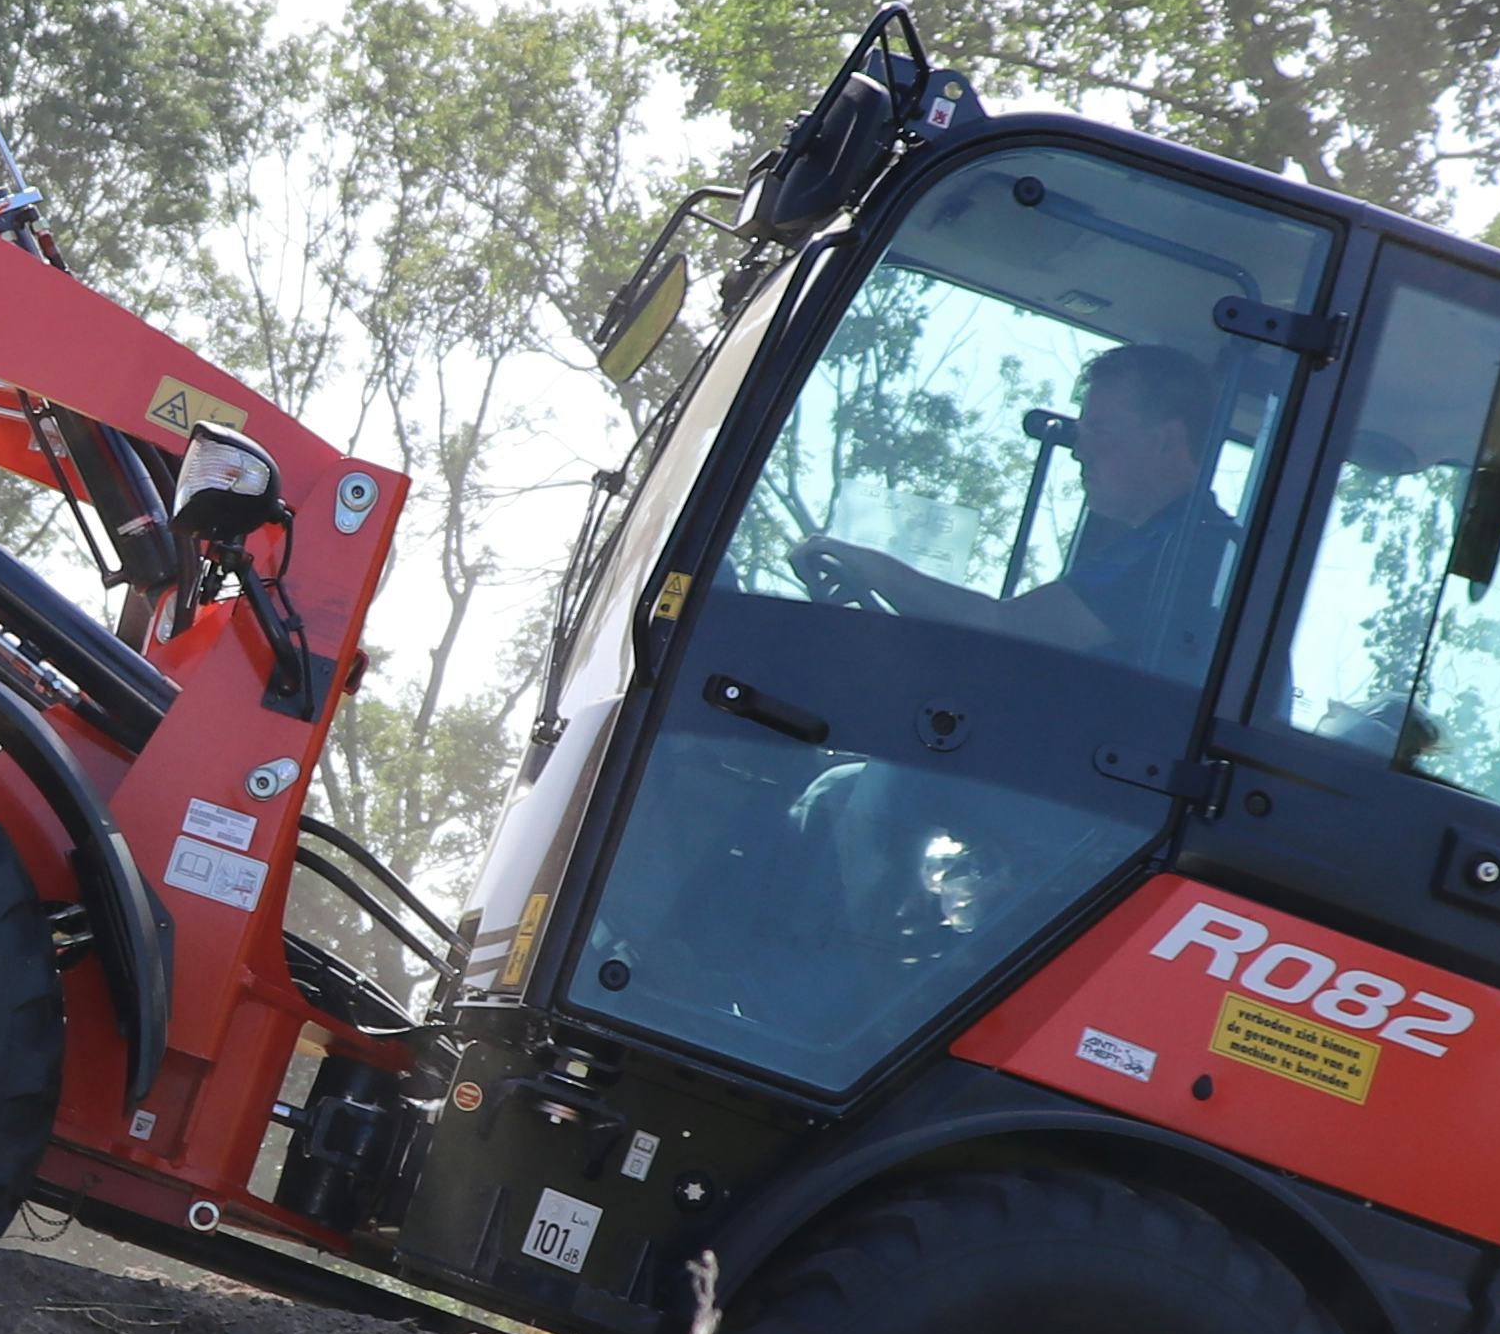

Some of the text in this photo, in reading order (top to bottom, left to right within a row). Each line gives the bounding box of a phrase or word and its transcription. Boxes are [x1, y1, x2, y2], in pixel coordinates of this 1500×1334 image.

[1149, 902, 1475, 1058] R082
[1227, 1020, 1363, 1077] de gevarenzone van de
[1239, 1009, 1360, 1060] verboden zich binnen
[1230, 1041, 1350, 1089] machine te bevinden
[532, 1219, 580, 1265] 101 dB
